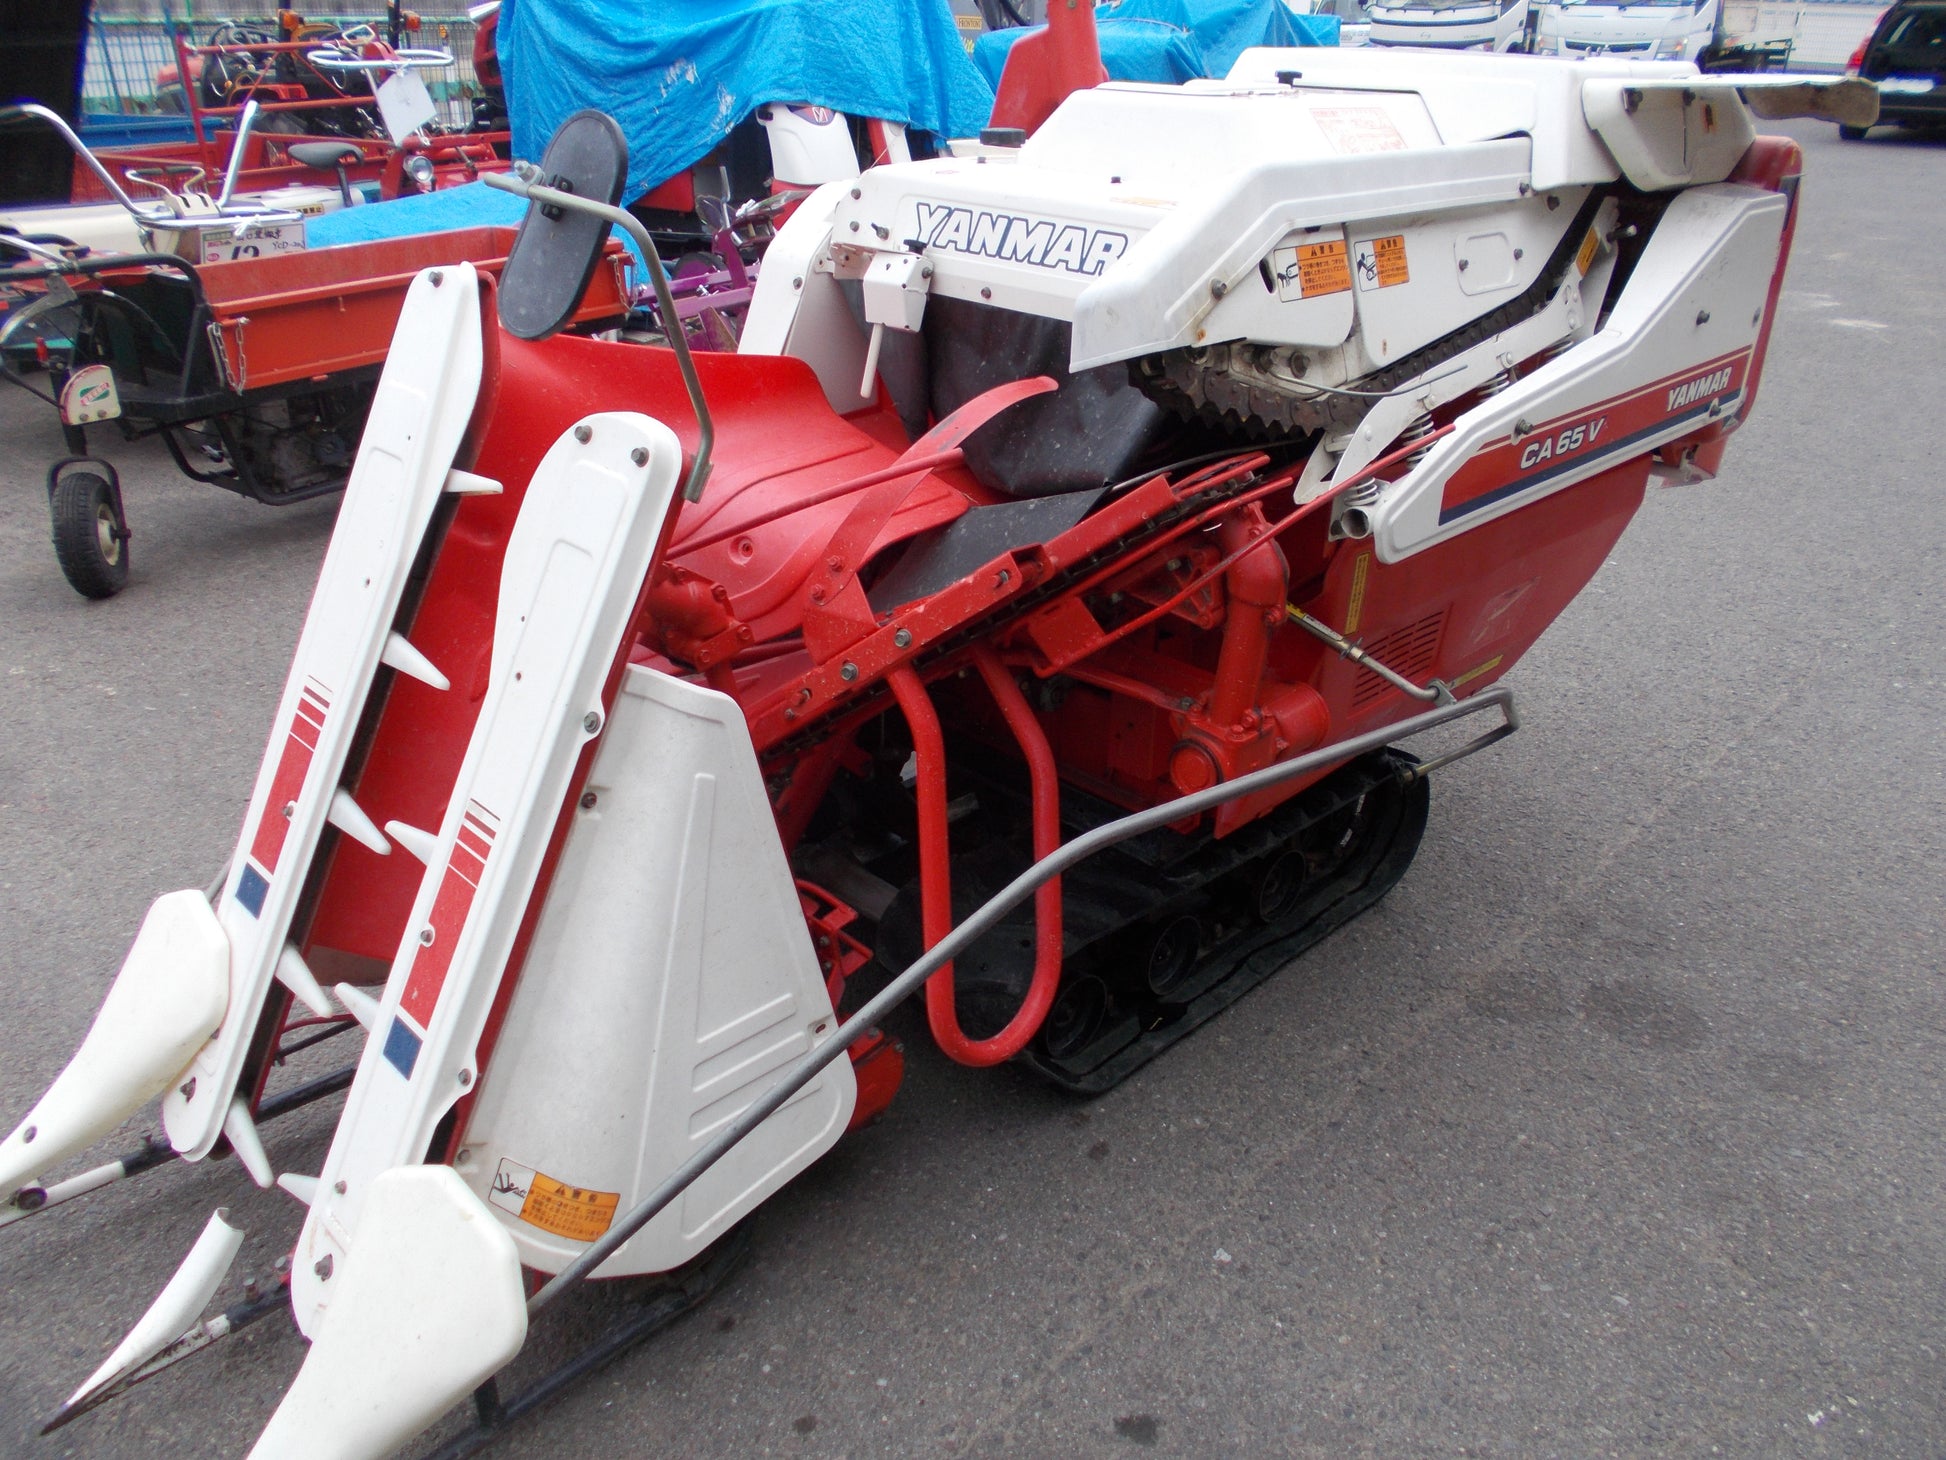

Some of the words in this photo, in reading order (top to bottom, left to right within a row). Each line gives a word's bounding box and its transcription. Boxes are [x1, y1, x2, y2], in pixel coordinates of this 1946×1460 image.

[917, 202, 1129, 277] YANMAR
[1666, 366, 1733, 412] YANMAR
[1519, 438, 1553, 470] CA
[1556, 424, 1587, 456] 65
[1588, 415, 1607, 443] V
